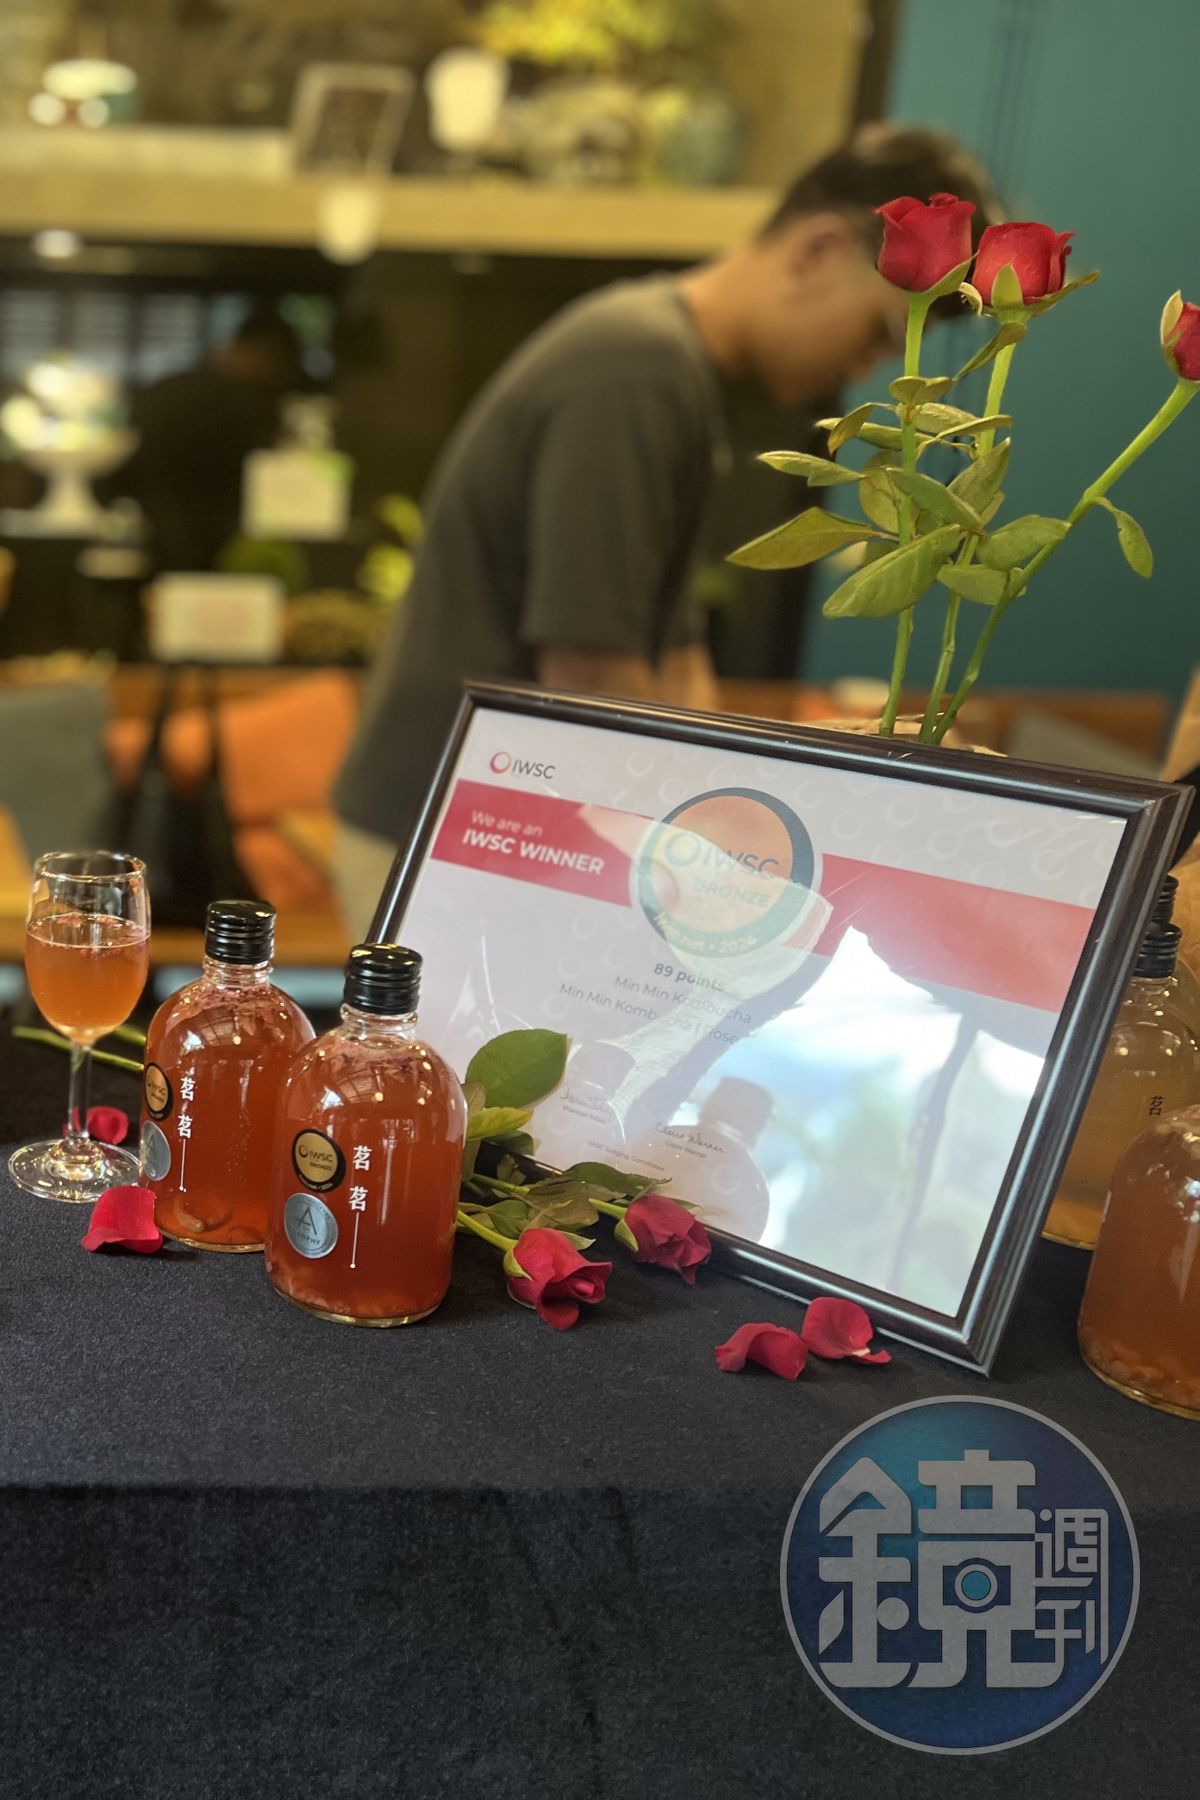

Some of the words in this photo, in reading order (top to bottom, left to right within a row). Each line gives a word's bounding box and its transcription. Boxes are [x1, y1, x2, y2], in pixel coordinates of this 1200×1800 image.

[511, 759, 556, 779] IWSC
[471, 810, 496, 827] We
[496, 818, 522, 833] are
[523, 823, 543, 837] an
[462, 828, 516, 854] IWSC
[518, 841, 605, 875] WINNER
[654, 963, 674, 978] 89
[675, 971, 725, 992] points
[560, 983, 584, 1000] Min
[587, 991, 611, 1008] Min
[614, 976, 640, 993] Min
[642, 983, 670, 1000] Min
[672, 992, 751, 1024] Kombucha
[349, 1145, 372, 1212] 茗茗
